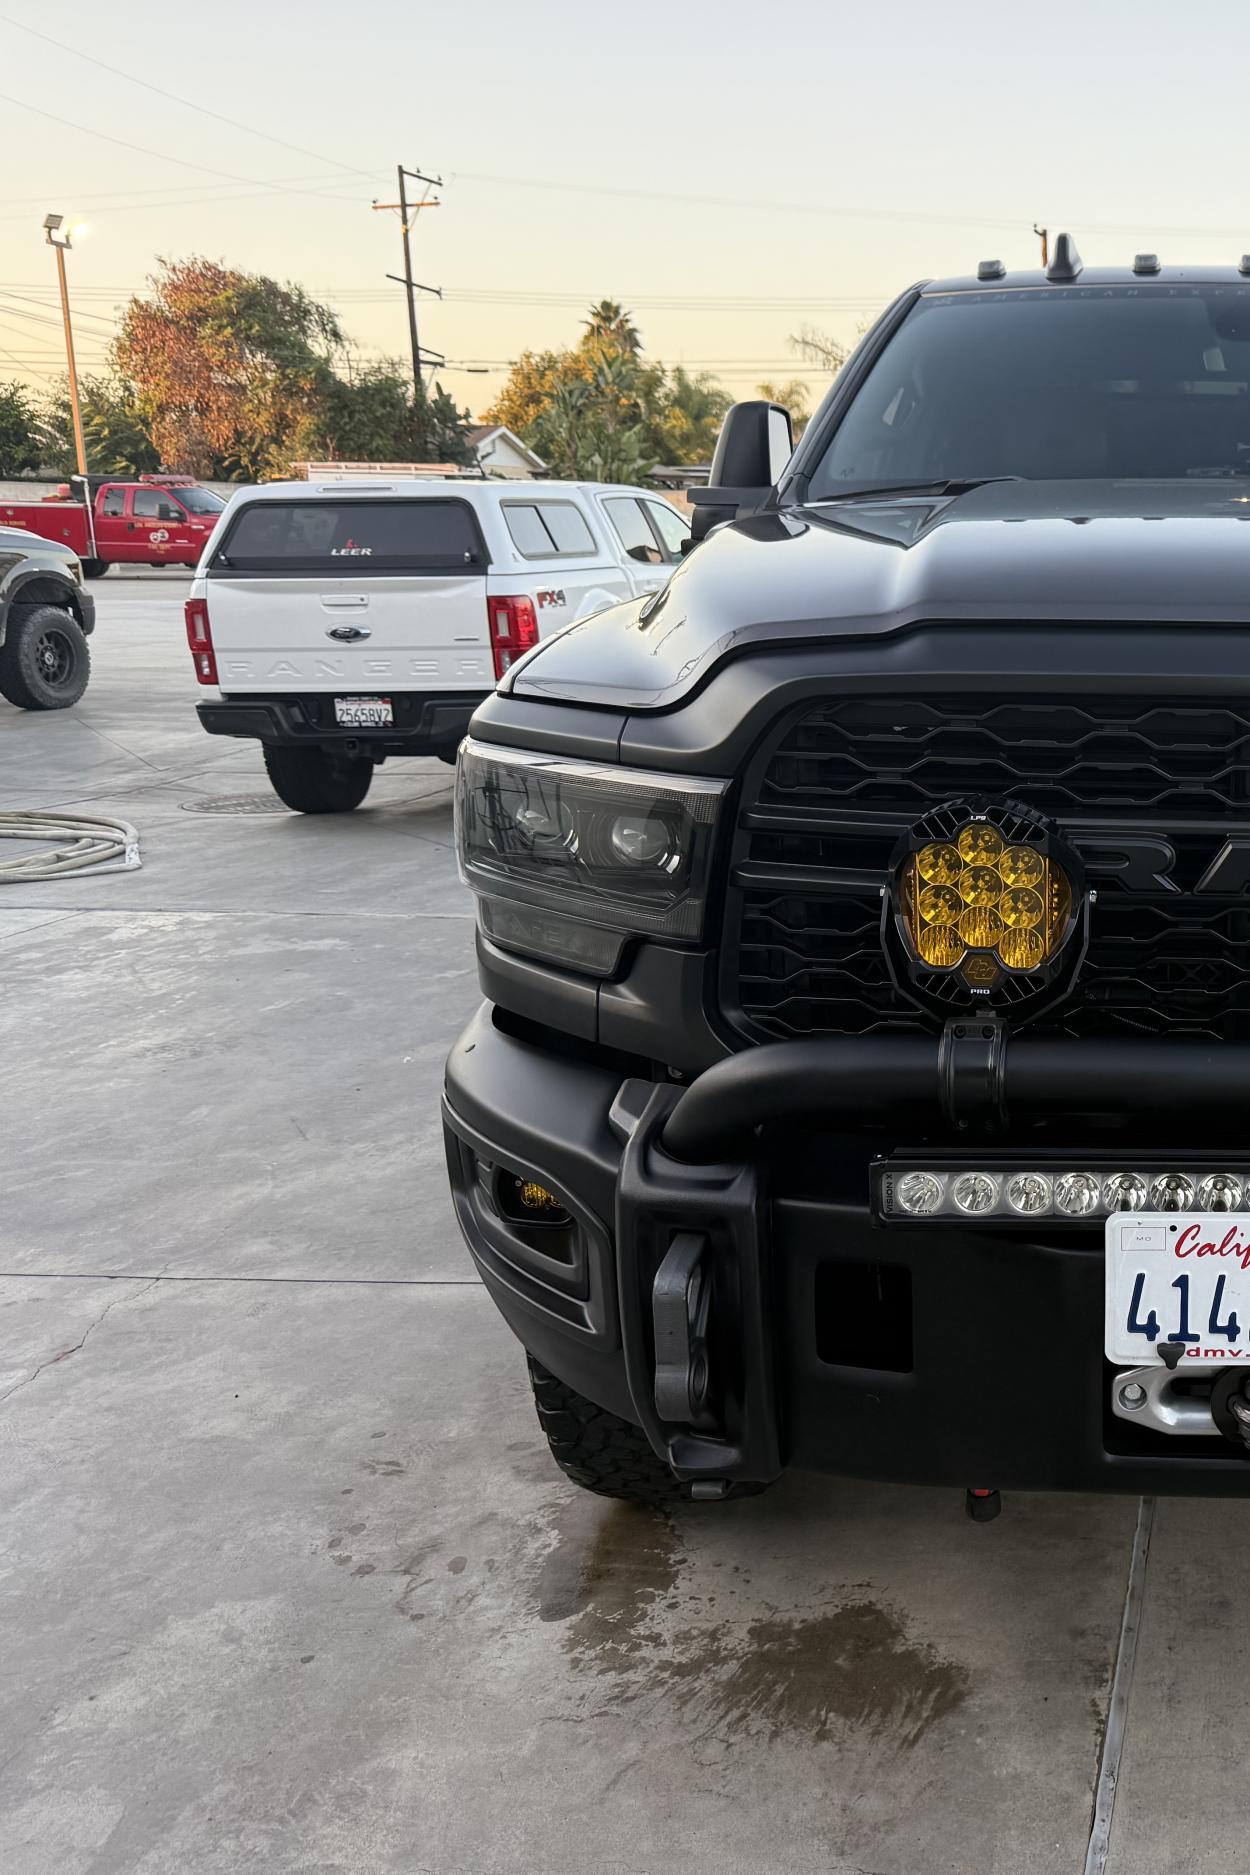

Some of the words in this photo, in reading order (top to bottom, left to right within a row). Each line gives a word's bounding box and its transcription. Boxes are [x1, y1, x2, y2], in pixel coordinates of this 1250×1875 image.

[331, 548, 372, 556] LEER
[536, 590, 567, 608] FX4
[224, 659, 486, 678] RANGER
[886, 1182, 894, 1213] VISION
